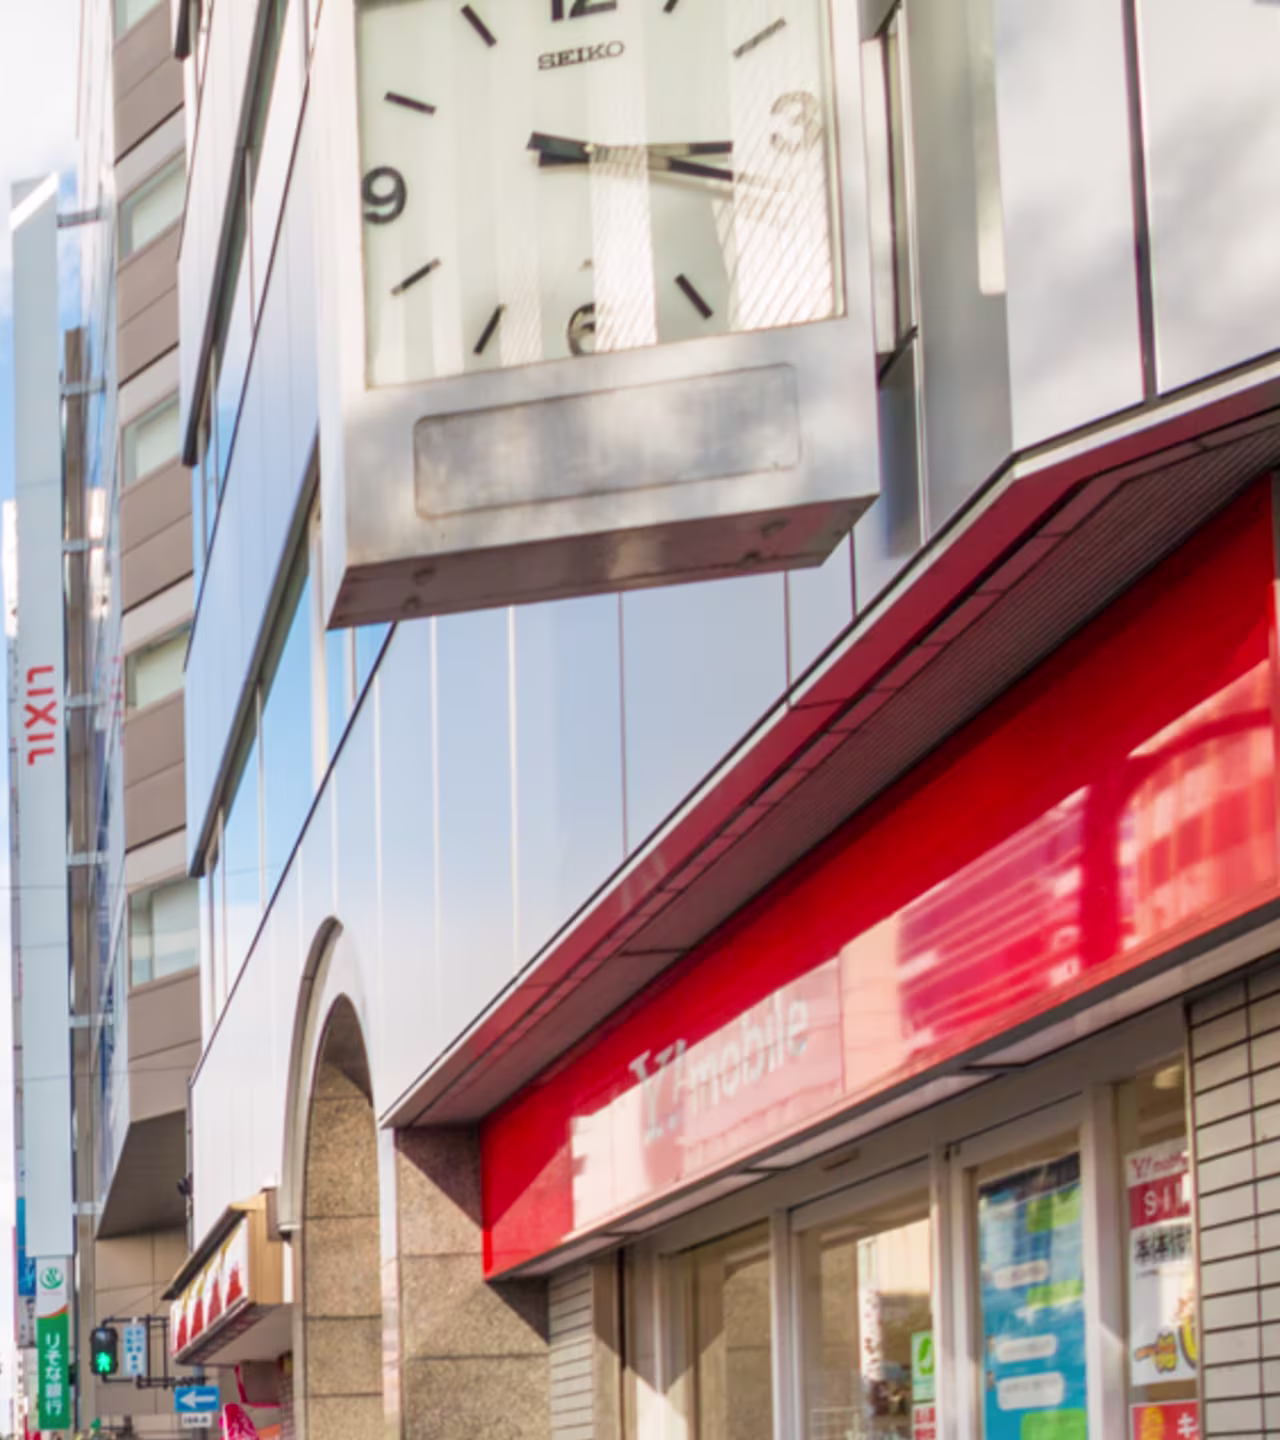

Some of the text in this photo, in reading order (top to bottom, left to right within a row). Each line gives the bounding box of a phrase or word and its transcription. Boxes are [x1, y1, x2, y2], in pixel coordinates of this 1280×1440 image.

[537, 40, 626, 71] SEIKO
[770, 91, 824, 156] 3
[361, 166, 408, 225] 9
[24, 664, 57, 765] LIXIL
[628, 988, 810, 1146] Y!mobile
[45, 1331, 62, 1417] りそな銀行
